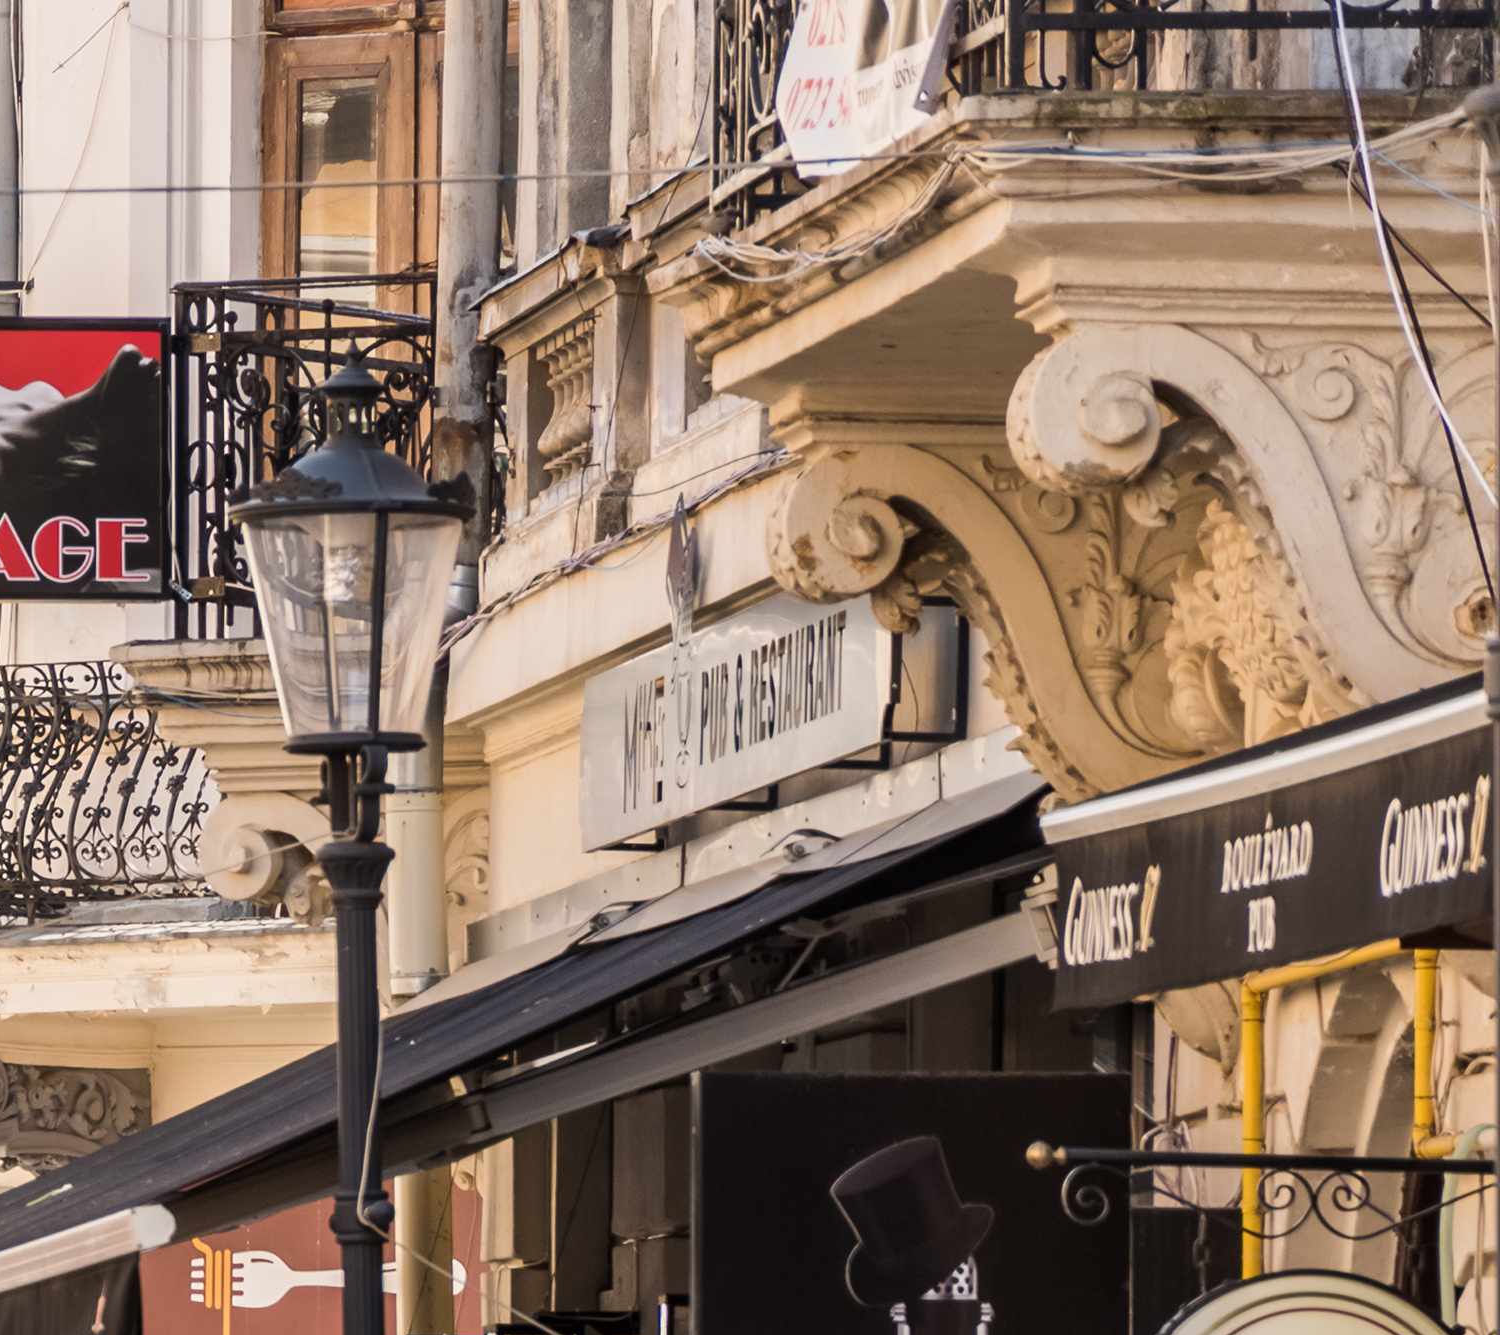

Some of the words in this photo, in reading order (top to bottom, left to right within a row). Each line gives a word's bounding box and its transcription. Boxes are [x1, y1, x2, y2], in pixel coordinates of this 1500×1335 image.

[1380, 793, 1469, 898] GUINNESS
[1064, 876, 1139, 966] GUINNESS
[1246, 896, 1276, 953] PUB
